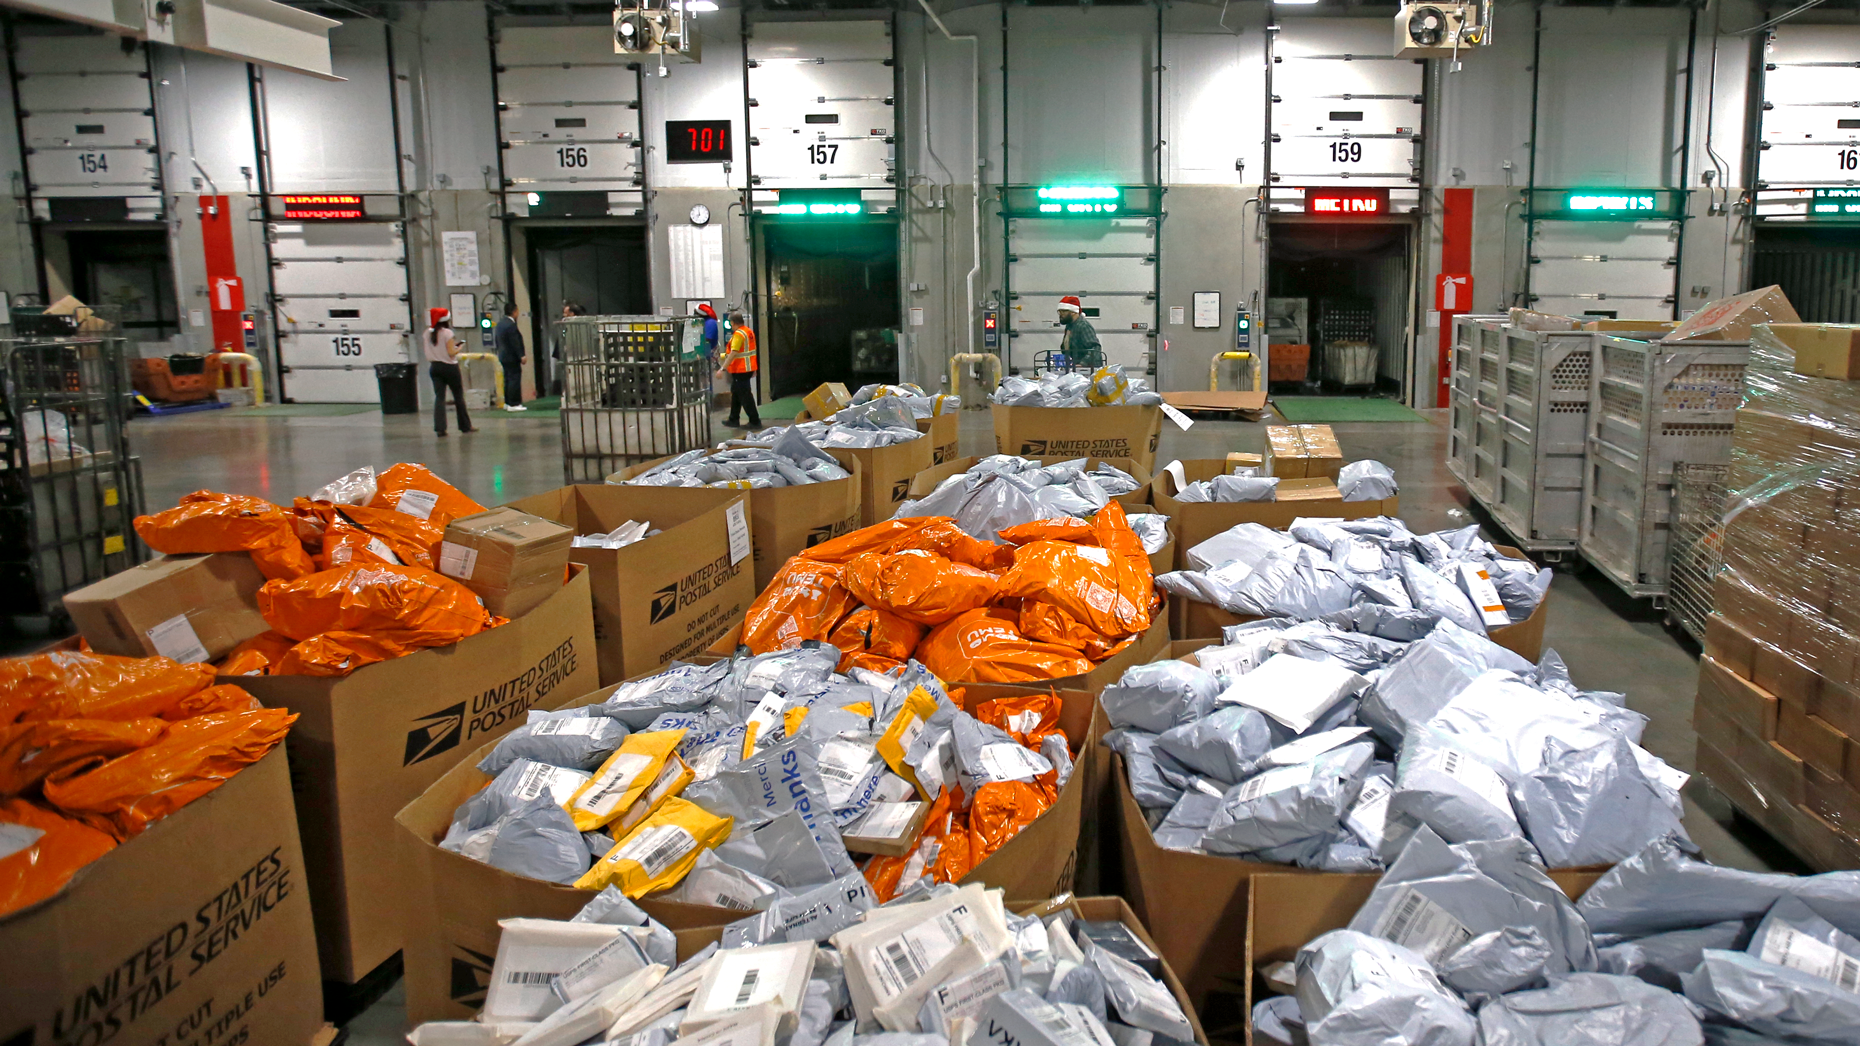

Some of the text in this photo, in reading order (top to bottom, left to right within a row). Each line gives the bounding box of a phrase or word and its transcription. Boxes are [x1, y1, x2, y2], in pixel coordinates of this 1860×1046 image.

[688, 127, 724, 152] 701
[1329, 141, 1362, 163] 159
[78, 153, 108, 173] 154
[556, 147, 588, 168] 156
[807, 144, 838, 165] 157
[1837, 149, 1860, 171] 16
[332, 337, 362, 357] 155
[1050, 438, 1127, 450] UNITED STATES
[680, 562, 713, 593] UNITED
[787, 571, 824, 588] TEMU
[678, 582, 712, 611] POSTAL
[686, 603, 720, 633] DO NOT CUT
[659, 603, 740, 665] DESIGNED FOR MULTIPLE USE
[472, 635, 574, 714] UNITED STATES
[467, 653, 578, 741] POSTAL SERVICE
[754, 762, 777, 808] Merci
[952, 905, 968, 915] F
[188, 869, 291, 978] SERVICE
[1461, 927, 1472, 941] F
[52, 845, 282, 1041] UNITED STATES
[257, 960, 288, 998] USE
[938, 986, 950, 1006] F
[175, 997, 215, 1042] CUT
